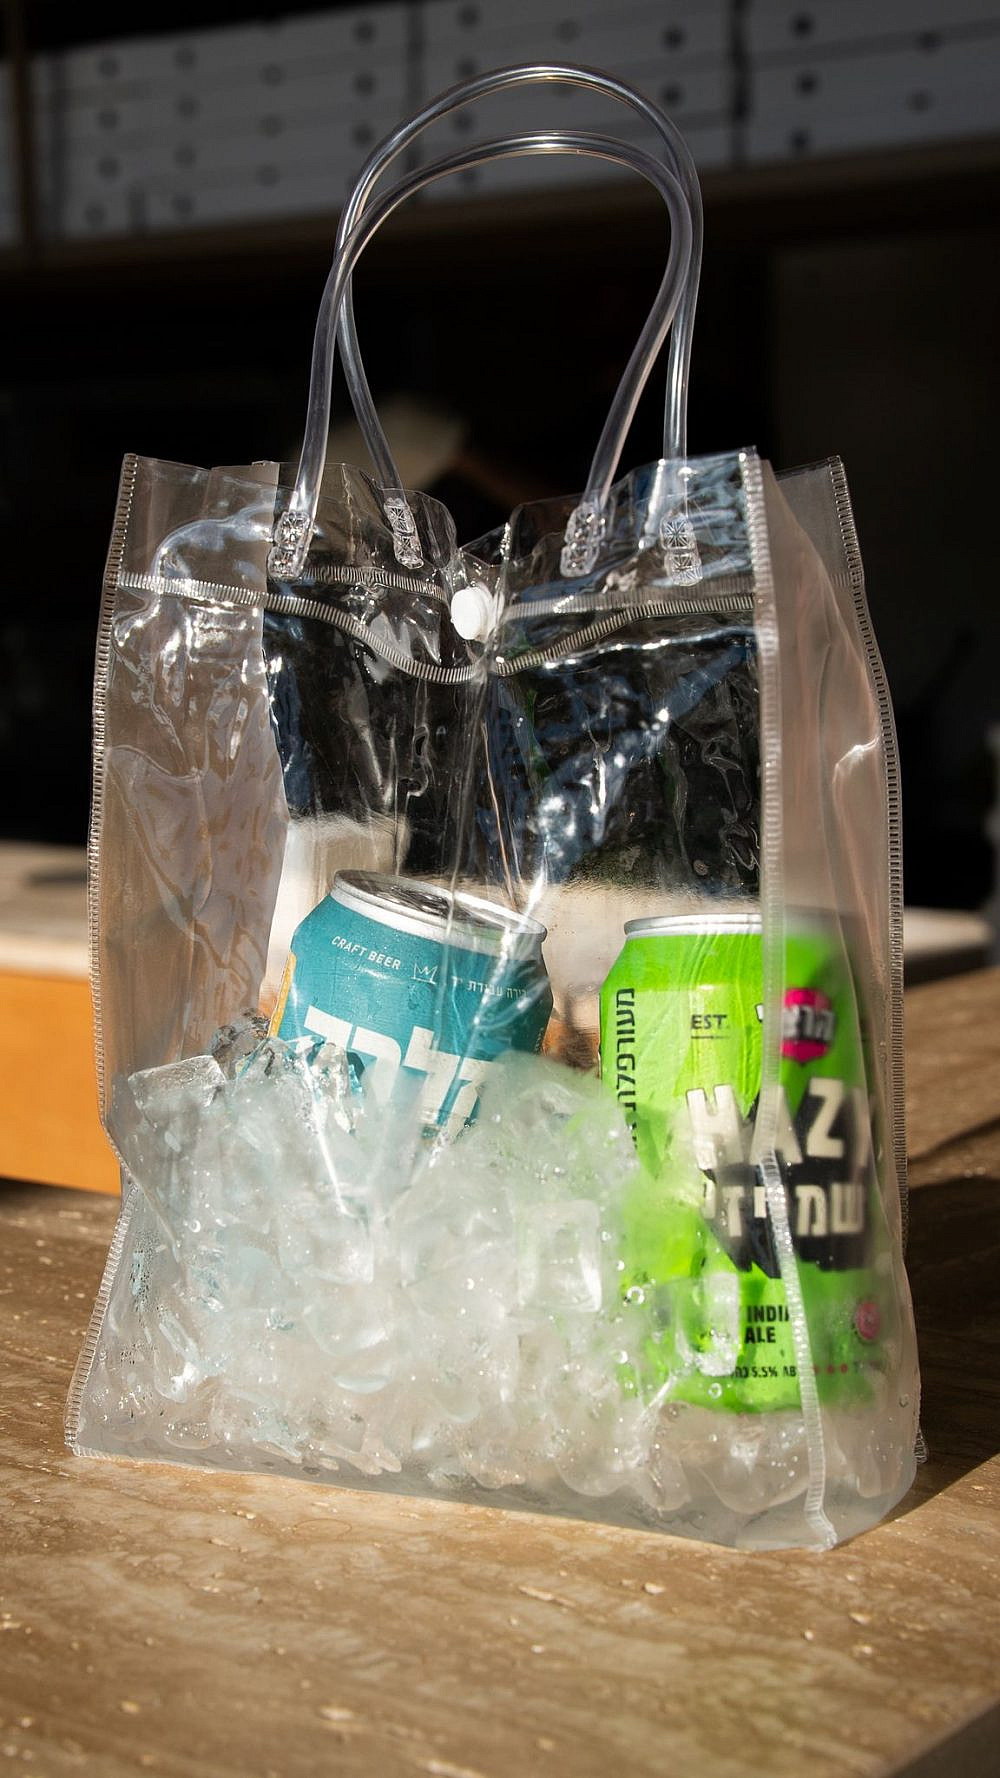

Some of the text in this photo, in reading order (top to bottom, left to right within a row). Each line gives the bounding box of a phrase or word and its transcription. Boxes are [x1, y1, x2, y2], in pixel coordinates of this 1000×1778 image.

[331, 935, 401, 970] CRAFT BEER
[744, 1326, 777, 1344] ALE
[751, 1366, 778, 1379] 5.5%
[783, 1366, 798, 1378] AB
